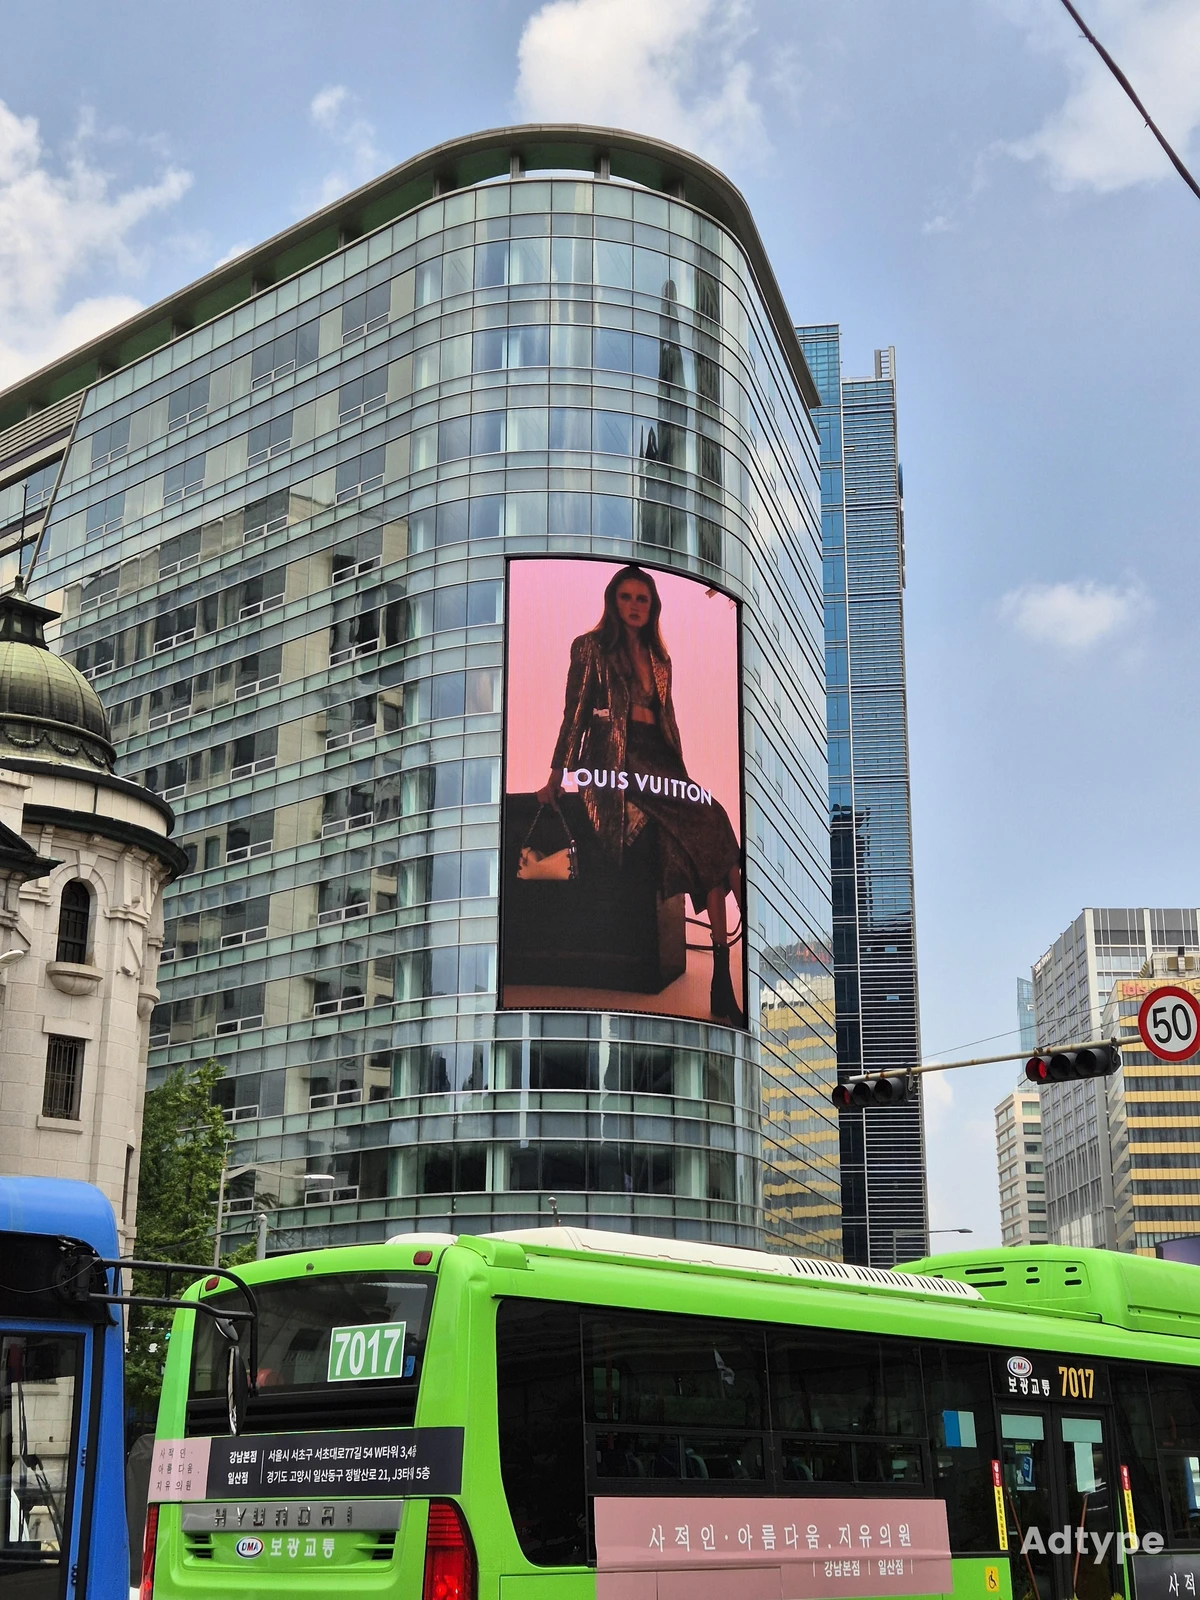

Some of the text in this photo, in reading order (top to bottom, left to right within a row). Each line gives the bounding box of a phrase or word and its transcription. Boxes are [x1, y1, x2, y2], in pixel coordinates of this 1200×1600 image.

[563, 767, 711, 805] LOUIS VUITTON
[1153, 1004, 1191, 1043] 50
[334, 1328, 401, 1376] 7017
[1009, 1377, 1050, 1396] 보광교통
[1058, 1366, 1094, 1398] 7017
[229, 1450, 257, 1464] 강남본점
[268, 1449, 289, 1462] 서울시
[291, 1448, 313, 1462] 서초구
[315, 1446, 361, 1461] 서초대로77길
[363, 1447, 373, 1459] 54
[374, 1445, 399, 1459] W타워
[228, 1471, 248, 1485] 일산점
[266, 1470, 288, 1483] 경기도
[289, 1469, 311, 1483] 고양시
[313, 1469, 343, 1483] 일산동구
[345, 1468, 376, 1482] 정발산로
[378, 1469, 391, 1482] 21,
[416, 1466, 430, 1480] 5층
[242, 1541, 258, 1551] DMA
[270, 1538, 335, 1558] 보광교통
[824, 1559, 904, 1577] 강남본점 일산점
